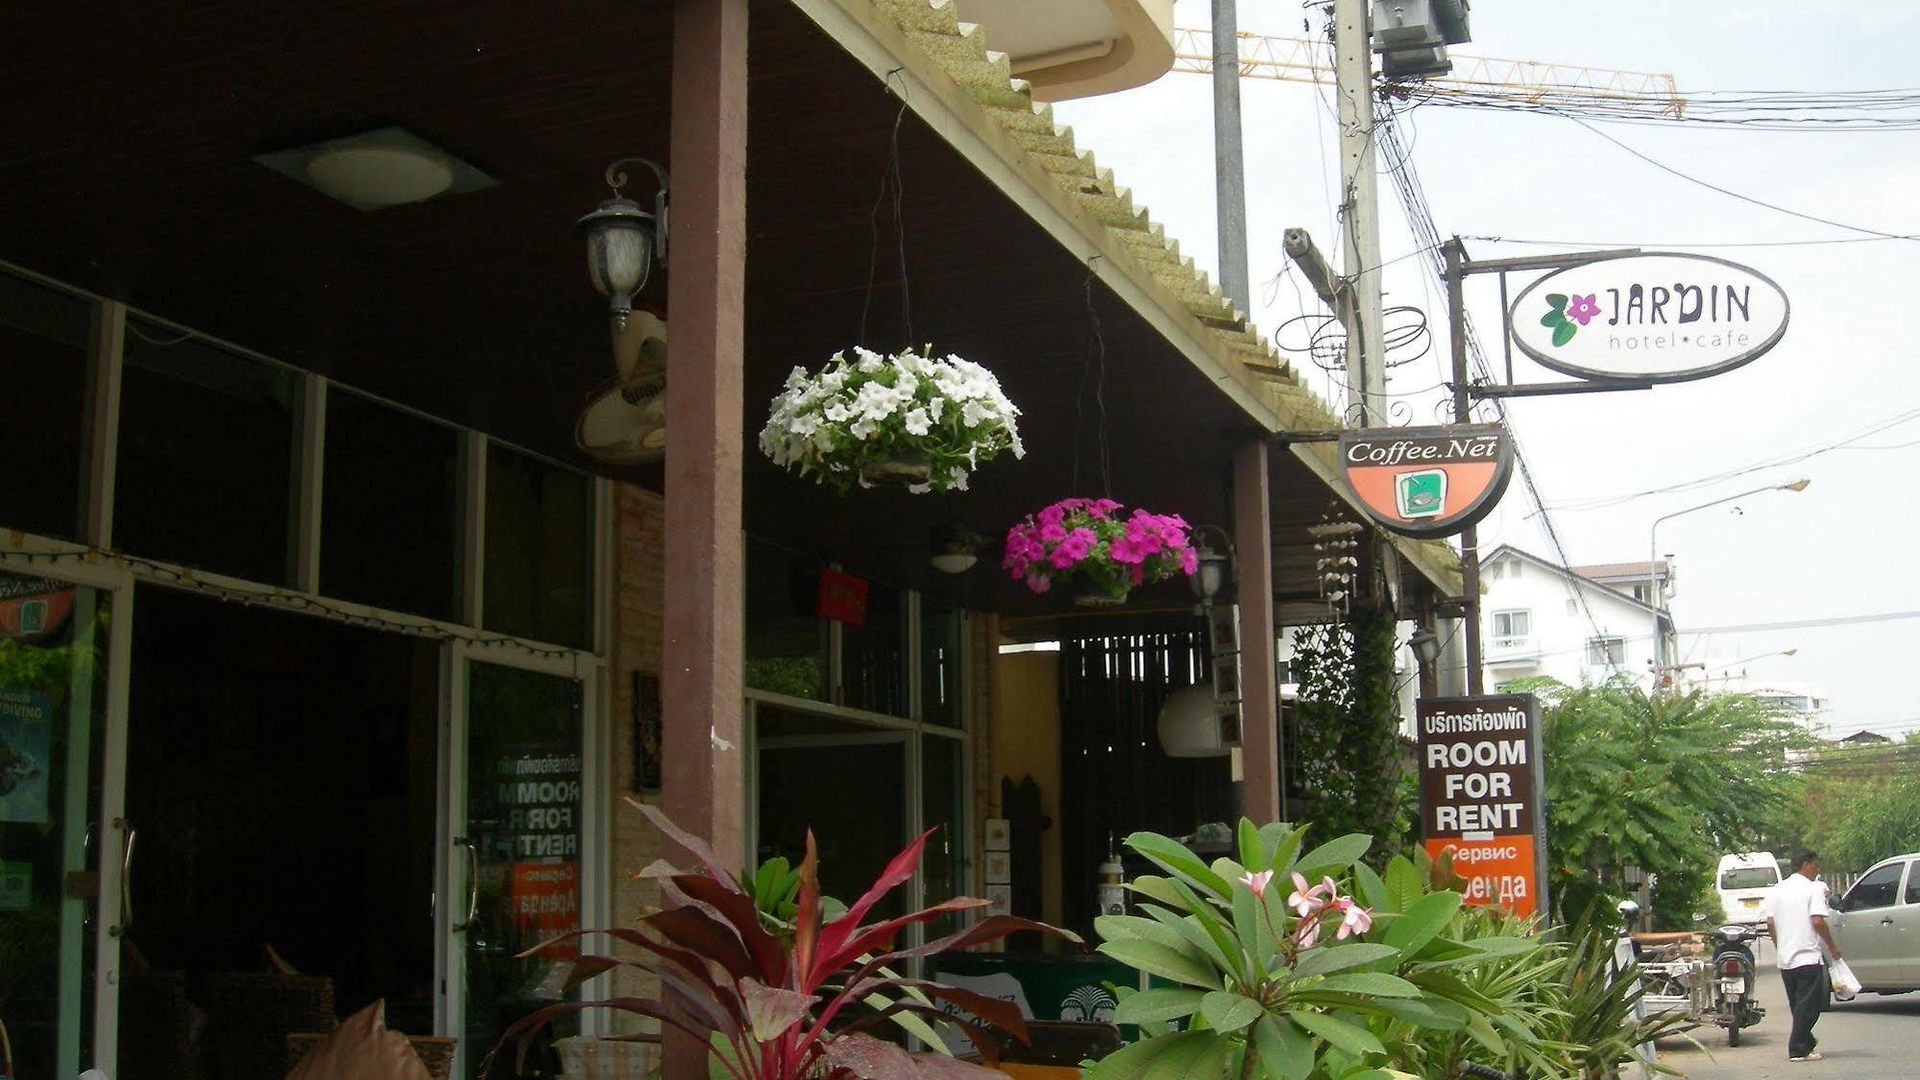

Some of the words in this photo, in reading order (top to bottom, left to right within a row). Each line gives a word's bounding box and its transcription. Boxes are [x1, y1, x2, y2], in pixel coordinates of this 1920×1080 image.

[1607, 283, 1750, 326] JARDIN
[1347, 438, 1497, 466] Coffee.Net
[0, 702, 42, 719] DIVING
[1425, 706, 1527, 734] บริการห้องพัก
[1427, 740, 1527, 768] ROOM
[1445, 772, 1512, 799] FOR
[1436, 803, 1524, 831] RENT
